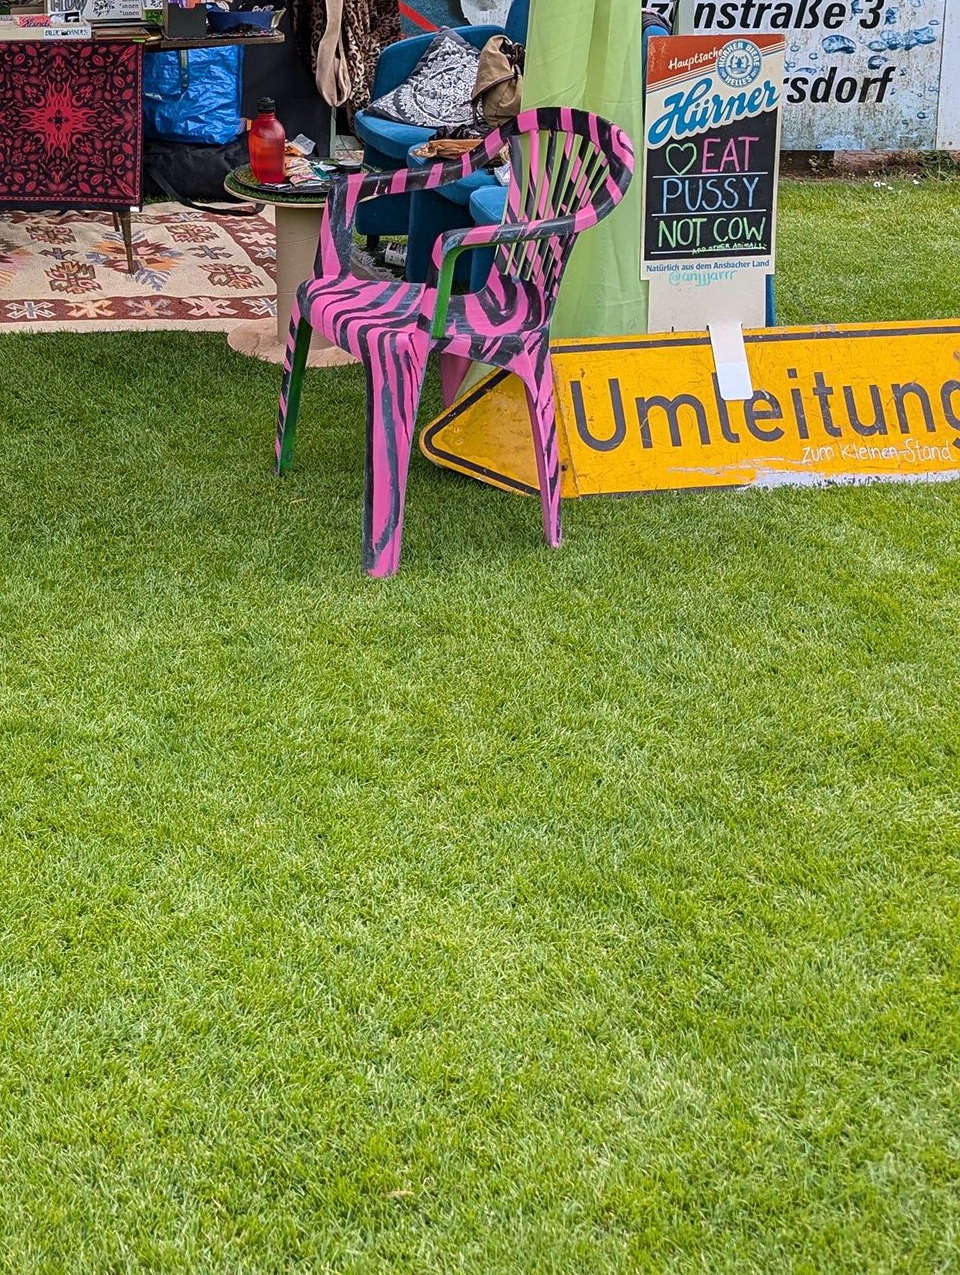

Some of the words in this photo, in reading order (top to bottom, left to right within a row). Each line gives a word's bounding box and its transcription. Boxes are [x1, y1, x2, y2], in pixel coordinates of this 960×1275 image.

[668, 47, 723, 71] Hauptsache
[745, 44, 760, 67] BIERE
[724, 75, 752, 86] HELLES
[647, 77, 781, 145] Hürner
[701, 136, 760, 173] EAT
[663, 177, 759, 214] PUSSY
[658, 218, 708, 248] NOT
[713, 216, 766, 243] COW
[646, 261, 680, 273] Natürlich
[681, 263, 694, 271] aus
[695, 260, 712, 271] dem
[713, 259, 751, 270] Ansbacher
[752, 259, 770, 268] Land
